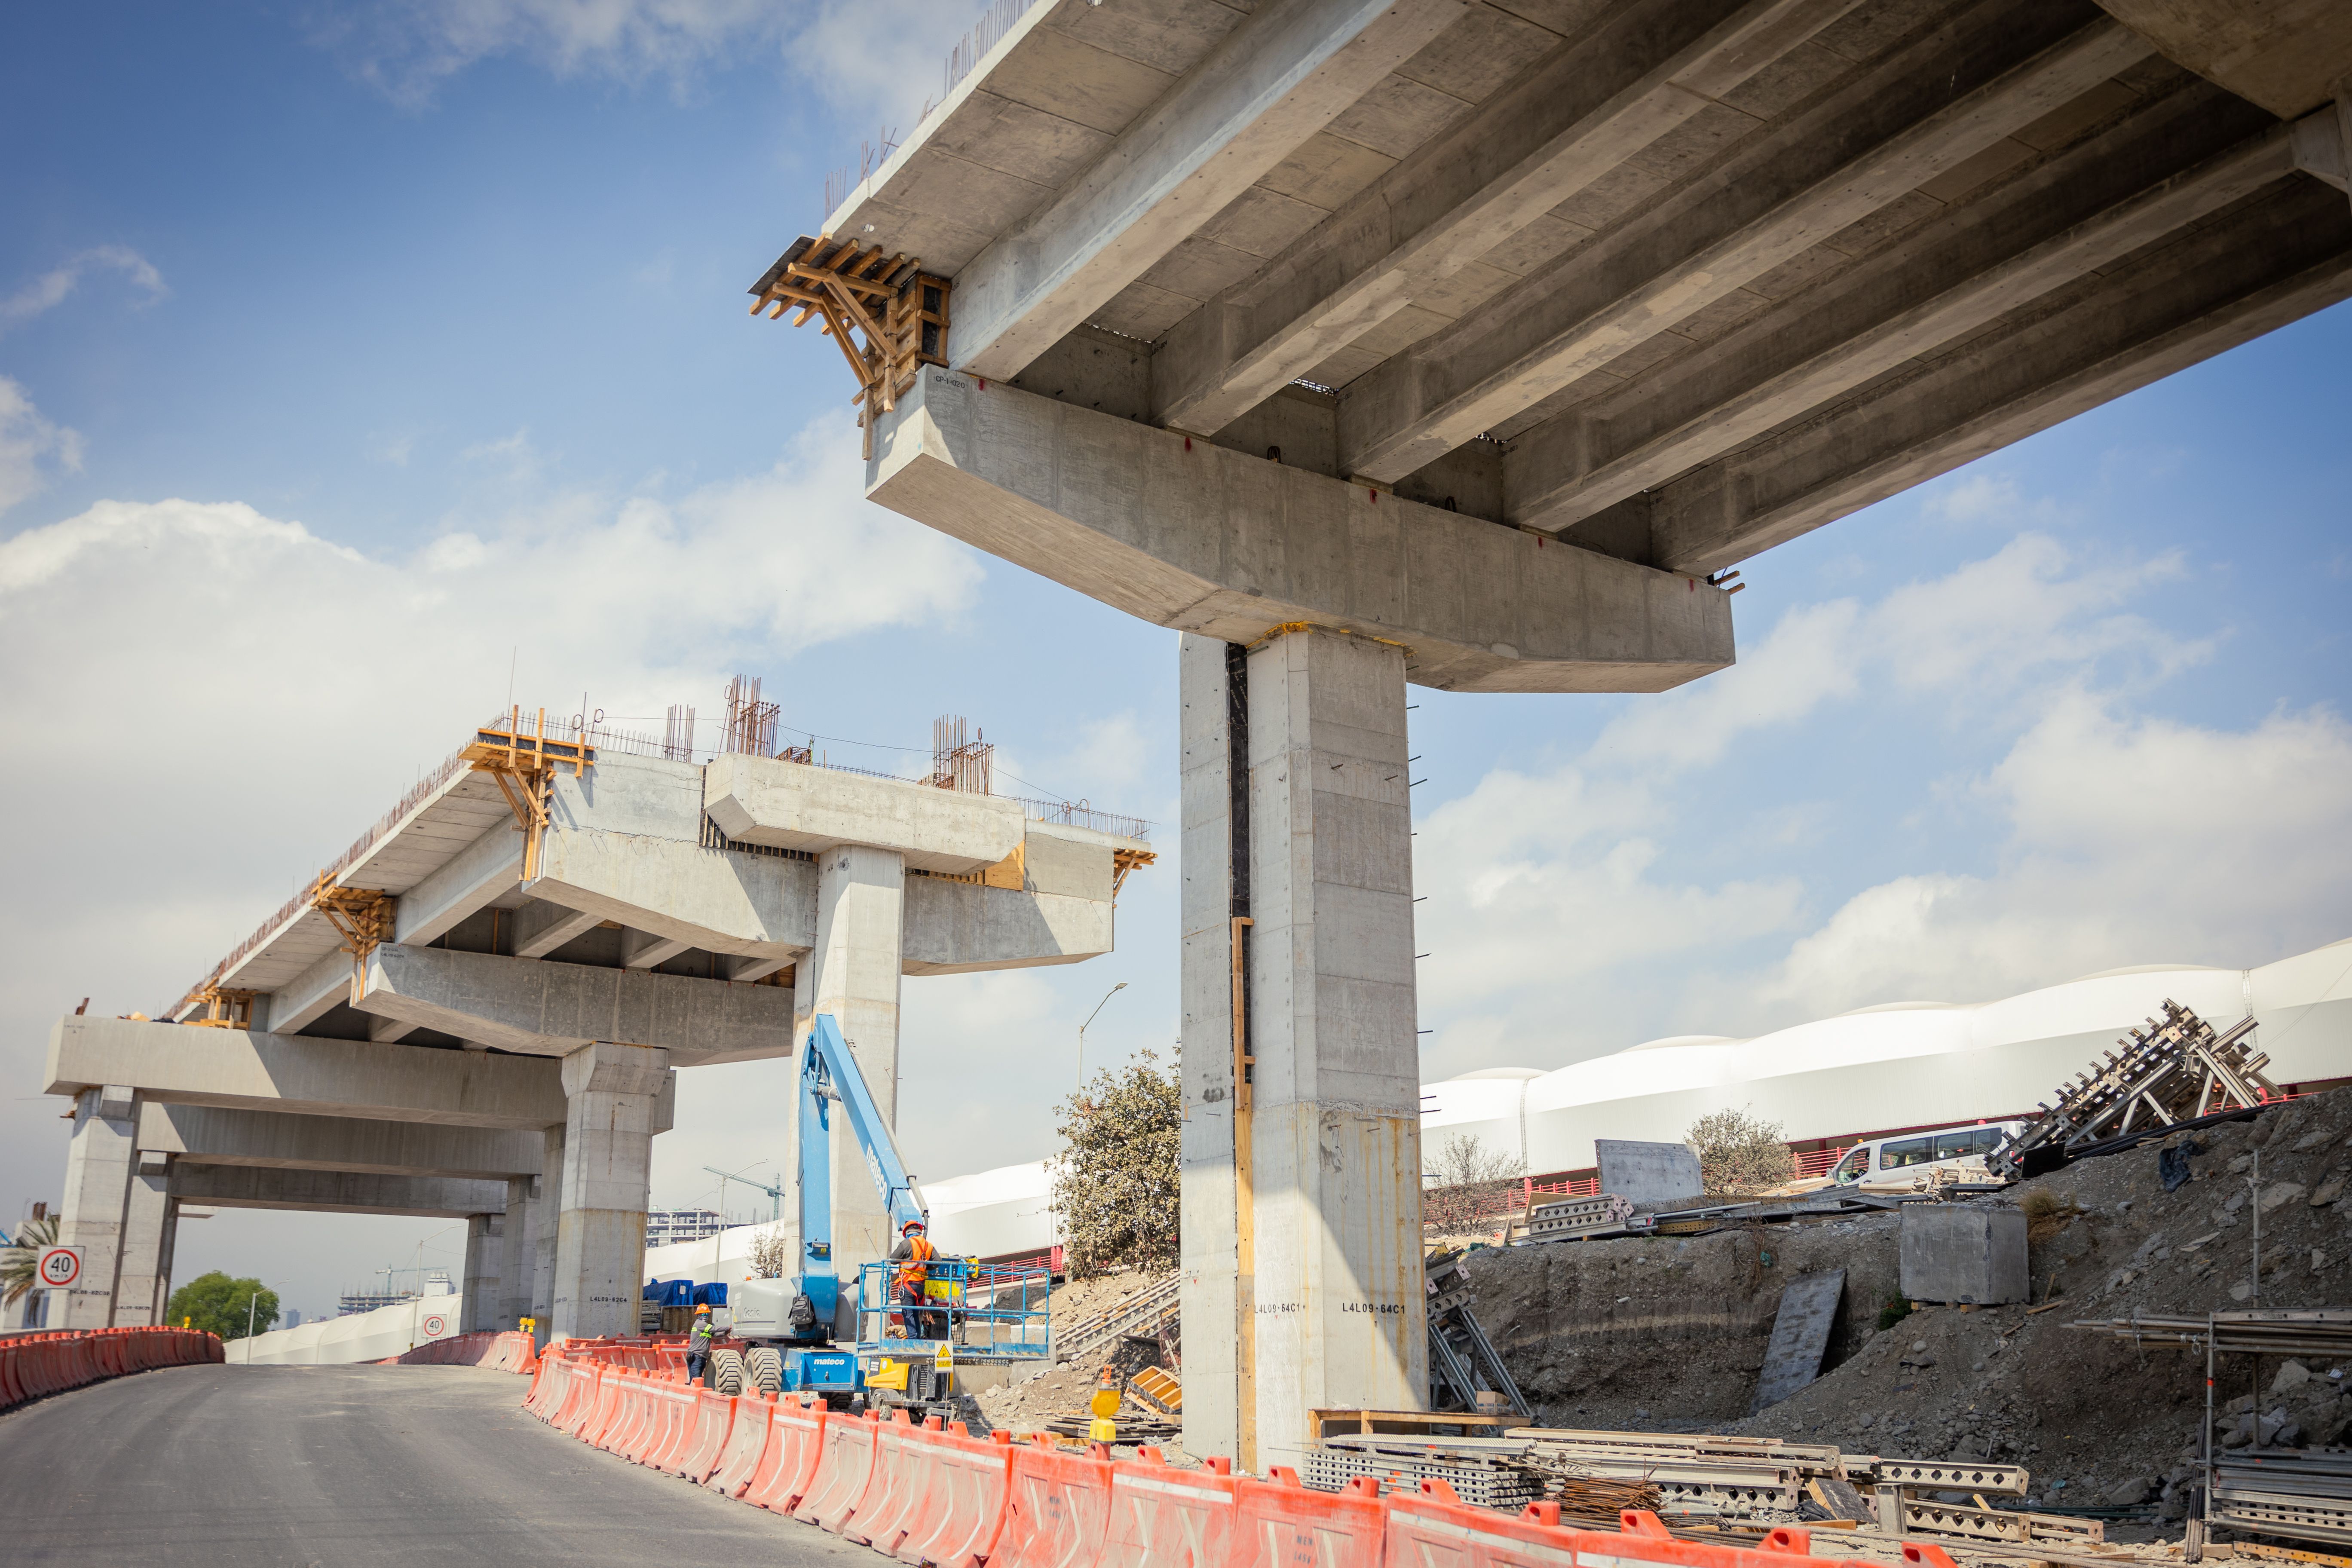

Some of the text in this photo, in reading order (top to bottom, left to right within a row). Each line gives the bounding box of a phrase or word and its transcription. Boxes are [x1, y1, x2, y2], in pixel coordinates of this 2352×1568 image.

[866, 1142, 888, 1200] mateco
[51, 1257, 70, 1272] 40
[1254, 1303, 1300, 1314] L4L09-64C1
[1342, 1303, 1405, 1314] L4L09-64C1
[429, 1320, 439, 1329] 40
[813, 1357, 845, 1366] mateco
